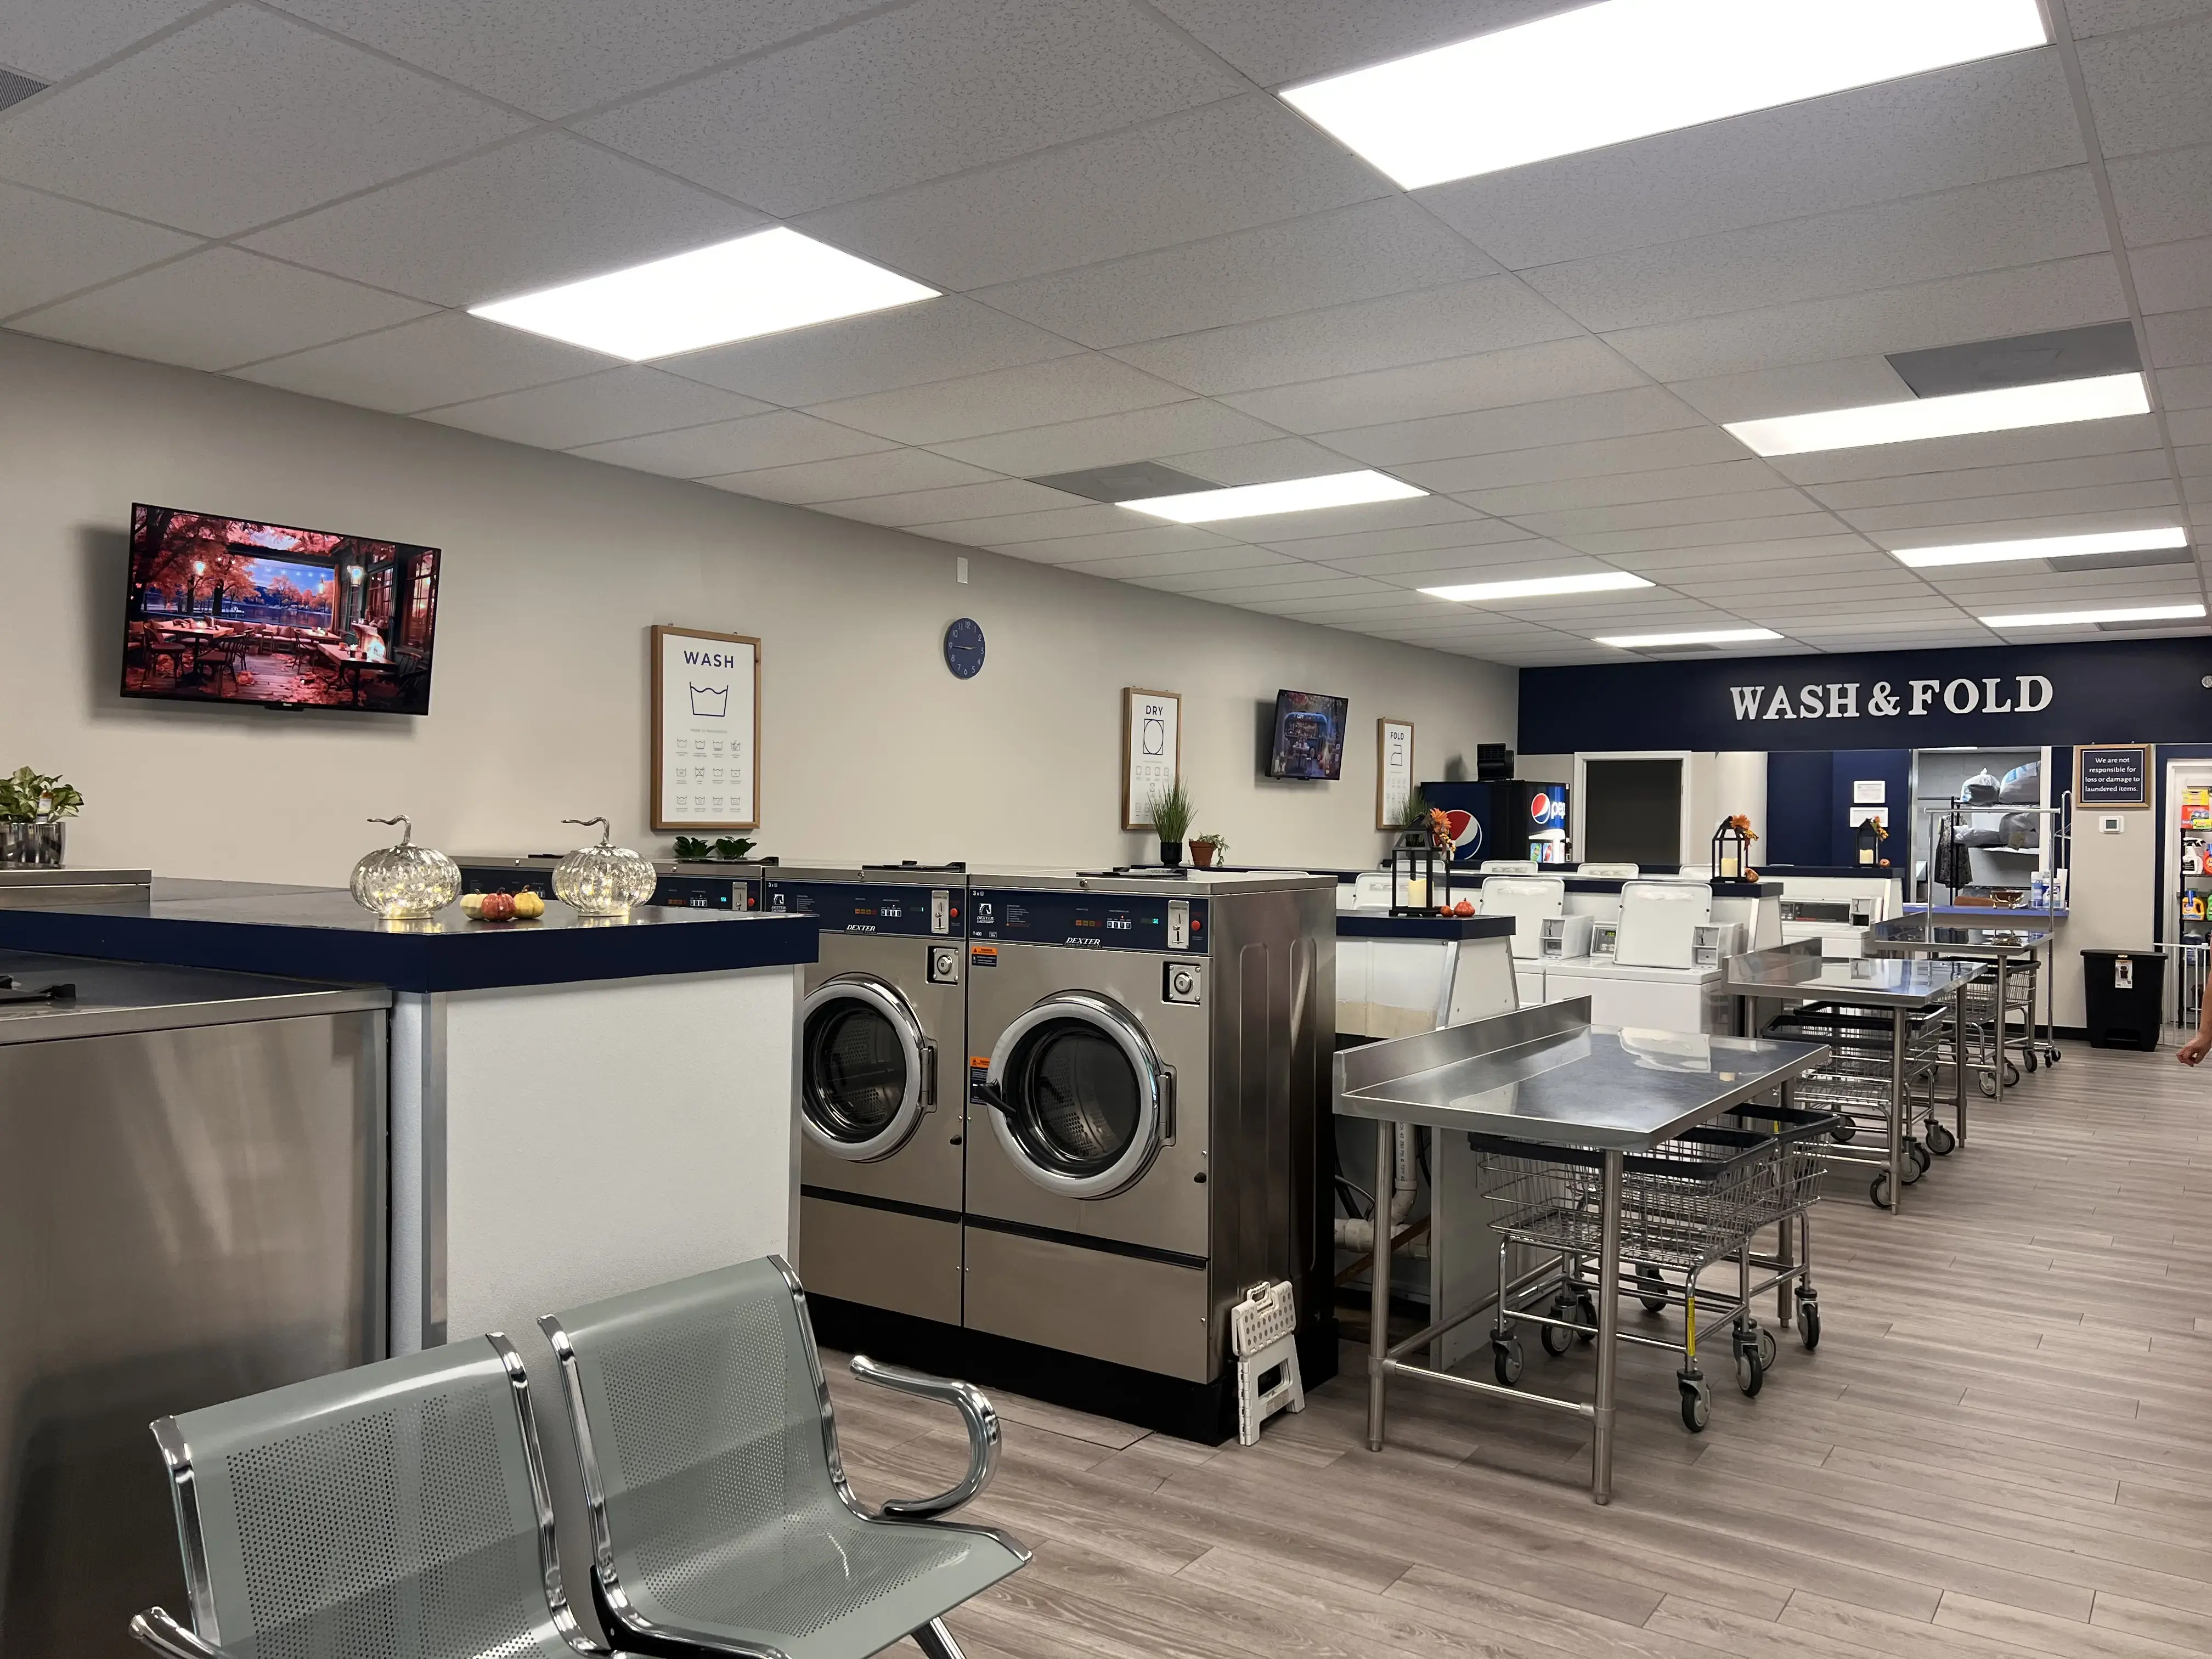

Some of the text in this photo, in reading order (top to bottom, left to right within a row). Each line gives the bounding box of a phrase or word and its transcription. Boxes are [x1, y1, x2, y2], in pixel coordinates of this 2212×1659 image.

[684, 650, 734, 668] WASH
[1730, 675, 2053, 720] WASH & FOLD
[1146, 705, 1163, 715] DRY
[1390, 731, 1404, 740] FOLD
[1065, 937, 1101, 945] DEXTER
